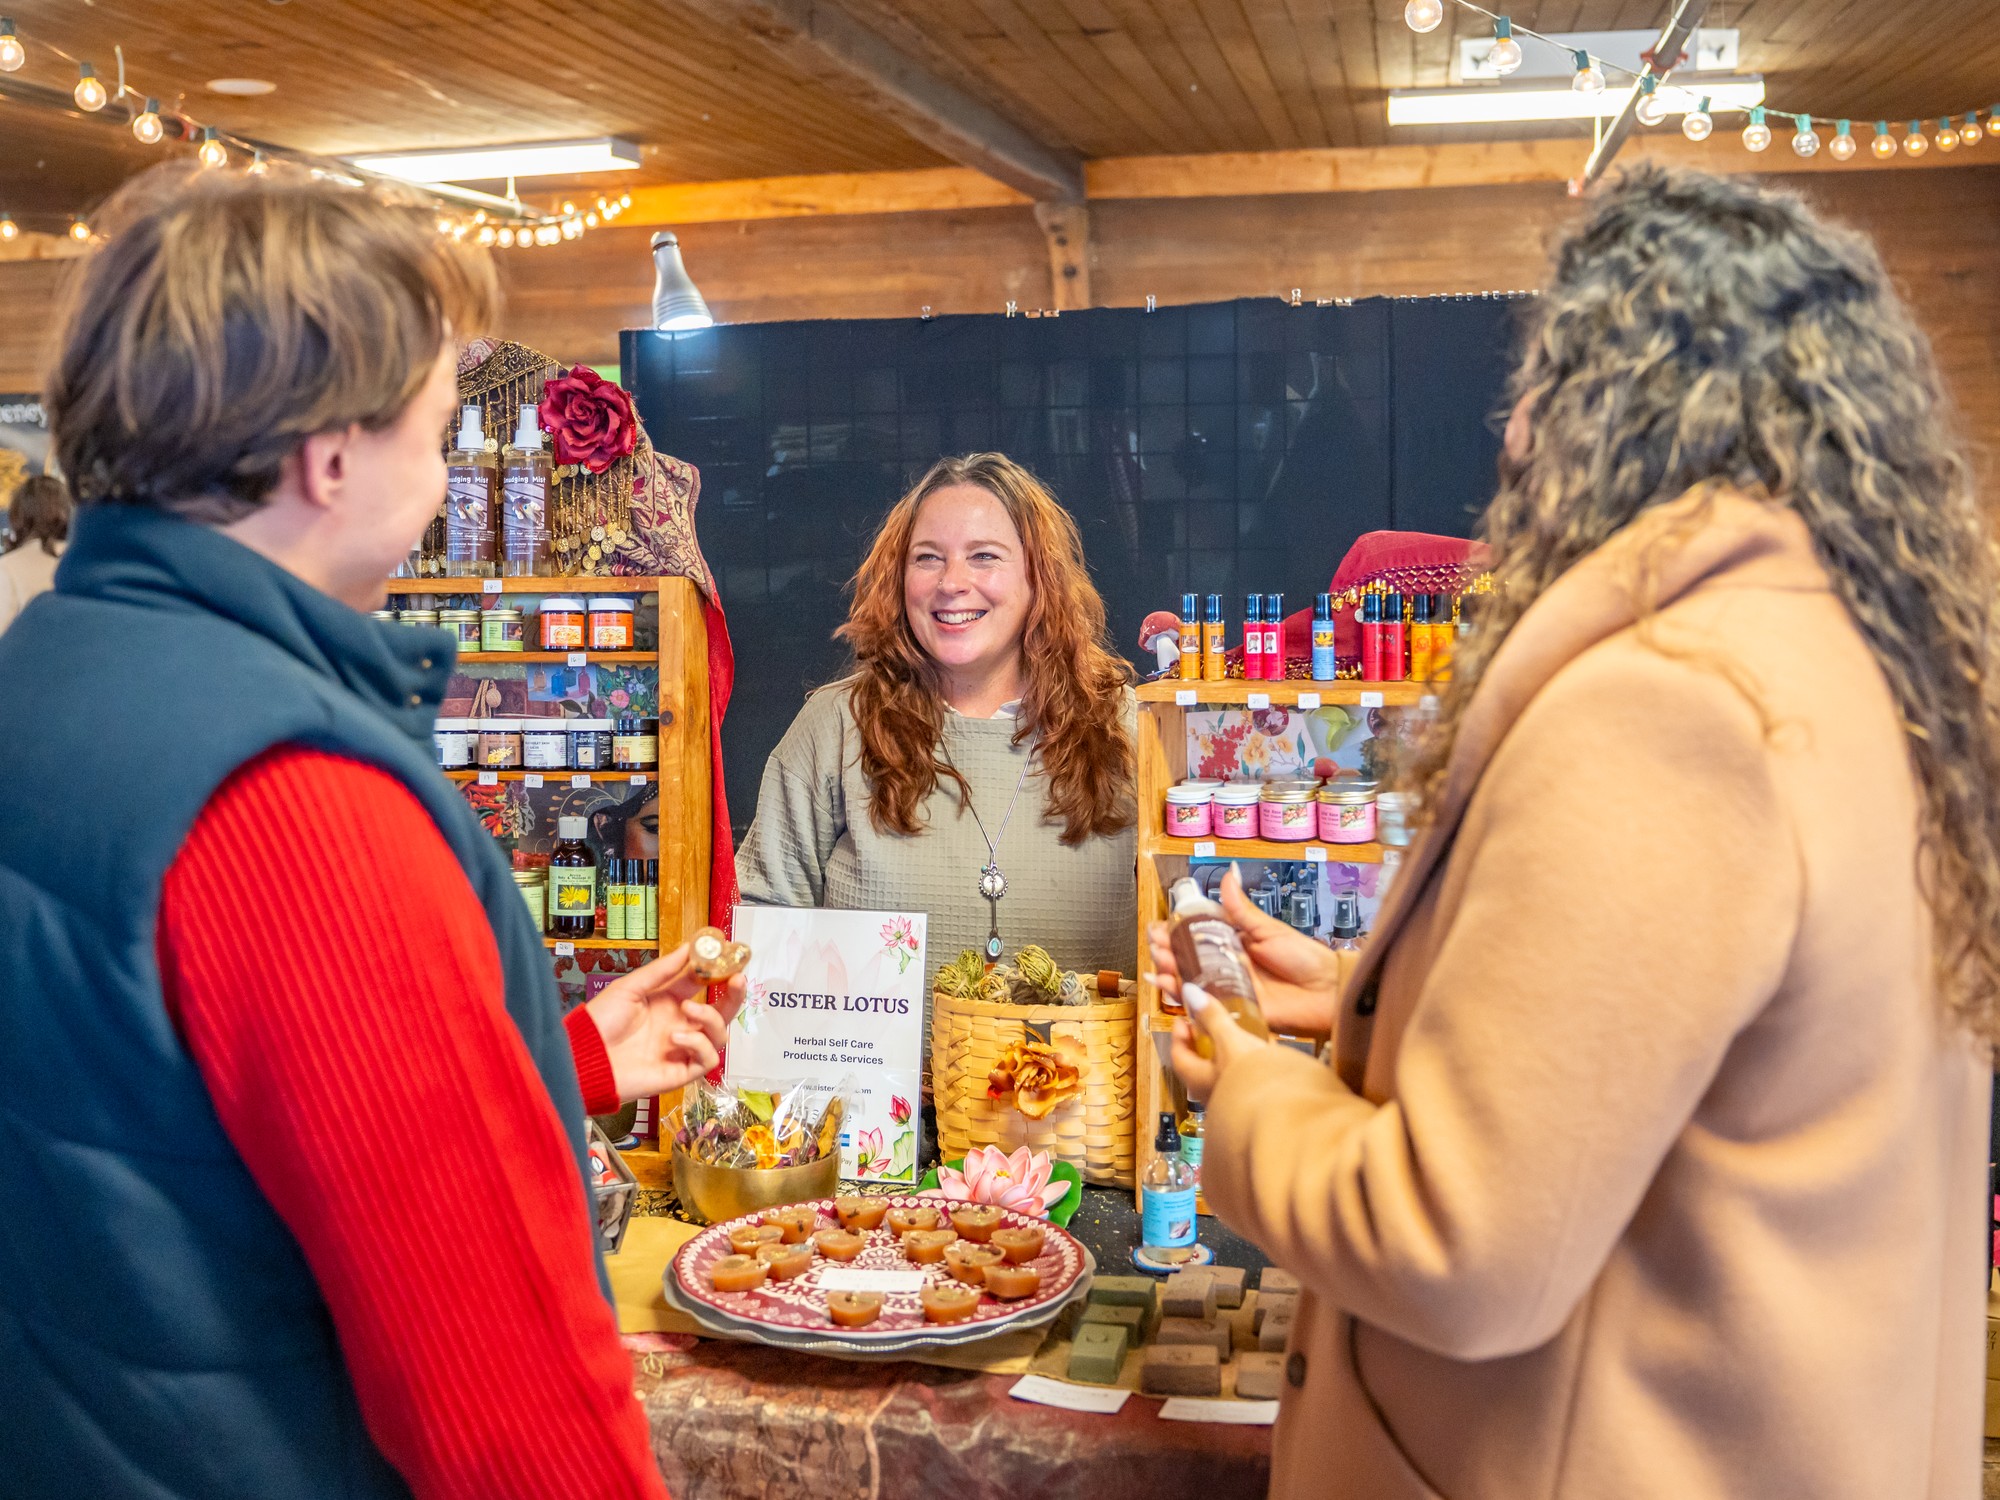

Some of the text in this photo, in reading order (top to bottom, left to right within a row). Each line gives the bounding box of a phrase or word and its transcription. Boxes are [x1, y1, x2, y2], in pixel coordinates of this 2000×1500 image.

[0, 403, 47, 428] eney
[768, 992, 909, 1014] SISTER LOTUS
[794, 1036, 874, 1049] Herbal Self Care
[783, 1050, 884, 1065] Products & Services
